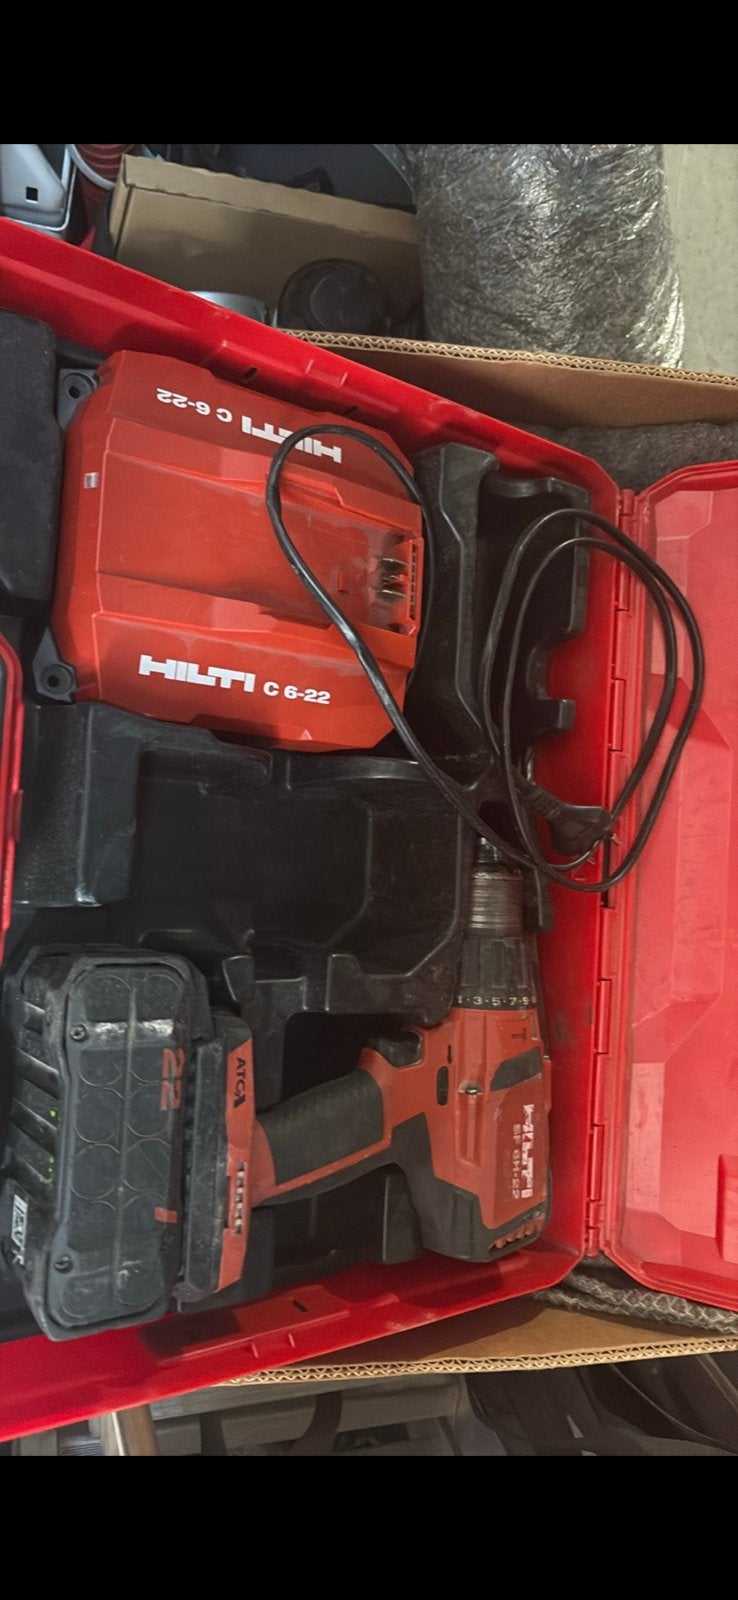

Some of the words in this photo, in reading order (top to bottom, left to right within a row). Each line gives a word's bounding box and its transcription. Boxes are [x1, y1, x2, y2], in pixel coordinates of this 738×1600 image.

[156, 388, 211, 416] 6-22
[216, 408, 233, 423] C
[138, 654, 256, 693] HILTI
[263, 681, 279, 697] C
[283, 685, 331, 705] 6-22
[160, 1048, 185, 1112] 22
